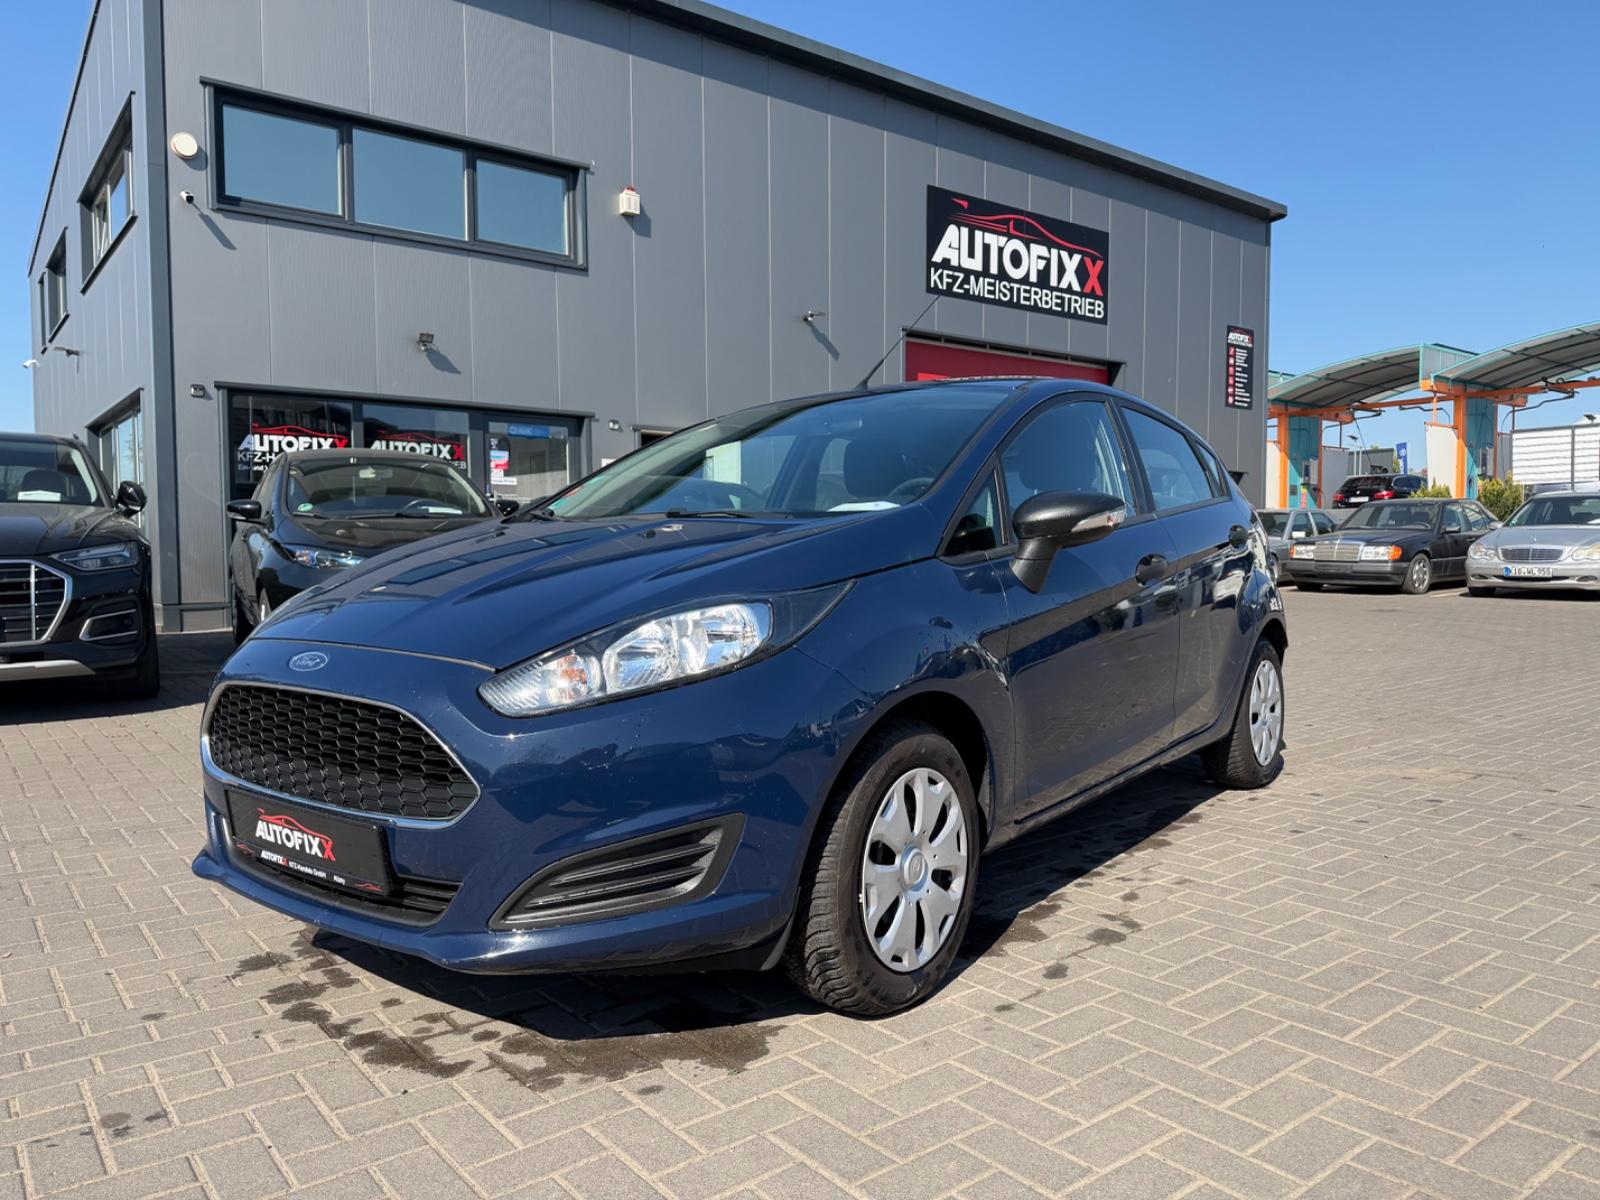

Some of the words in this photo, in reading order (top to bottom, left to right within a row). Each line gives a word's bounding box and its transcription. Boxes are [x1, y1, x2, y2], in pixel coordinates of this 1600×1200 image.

[931, 223, 1104, 297] AUTOFIXX
[930, 267, 1104, 319] KFZ-MEISTERBETRIEB
[255, 820, 336, 862] AUTOFIXX
